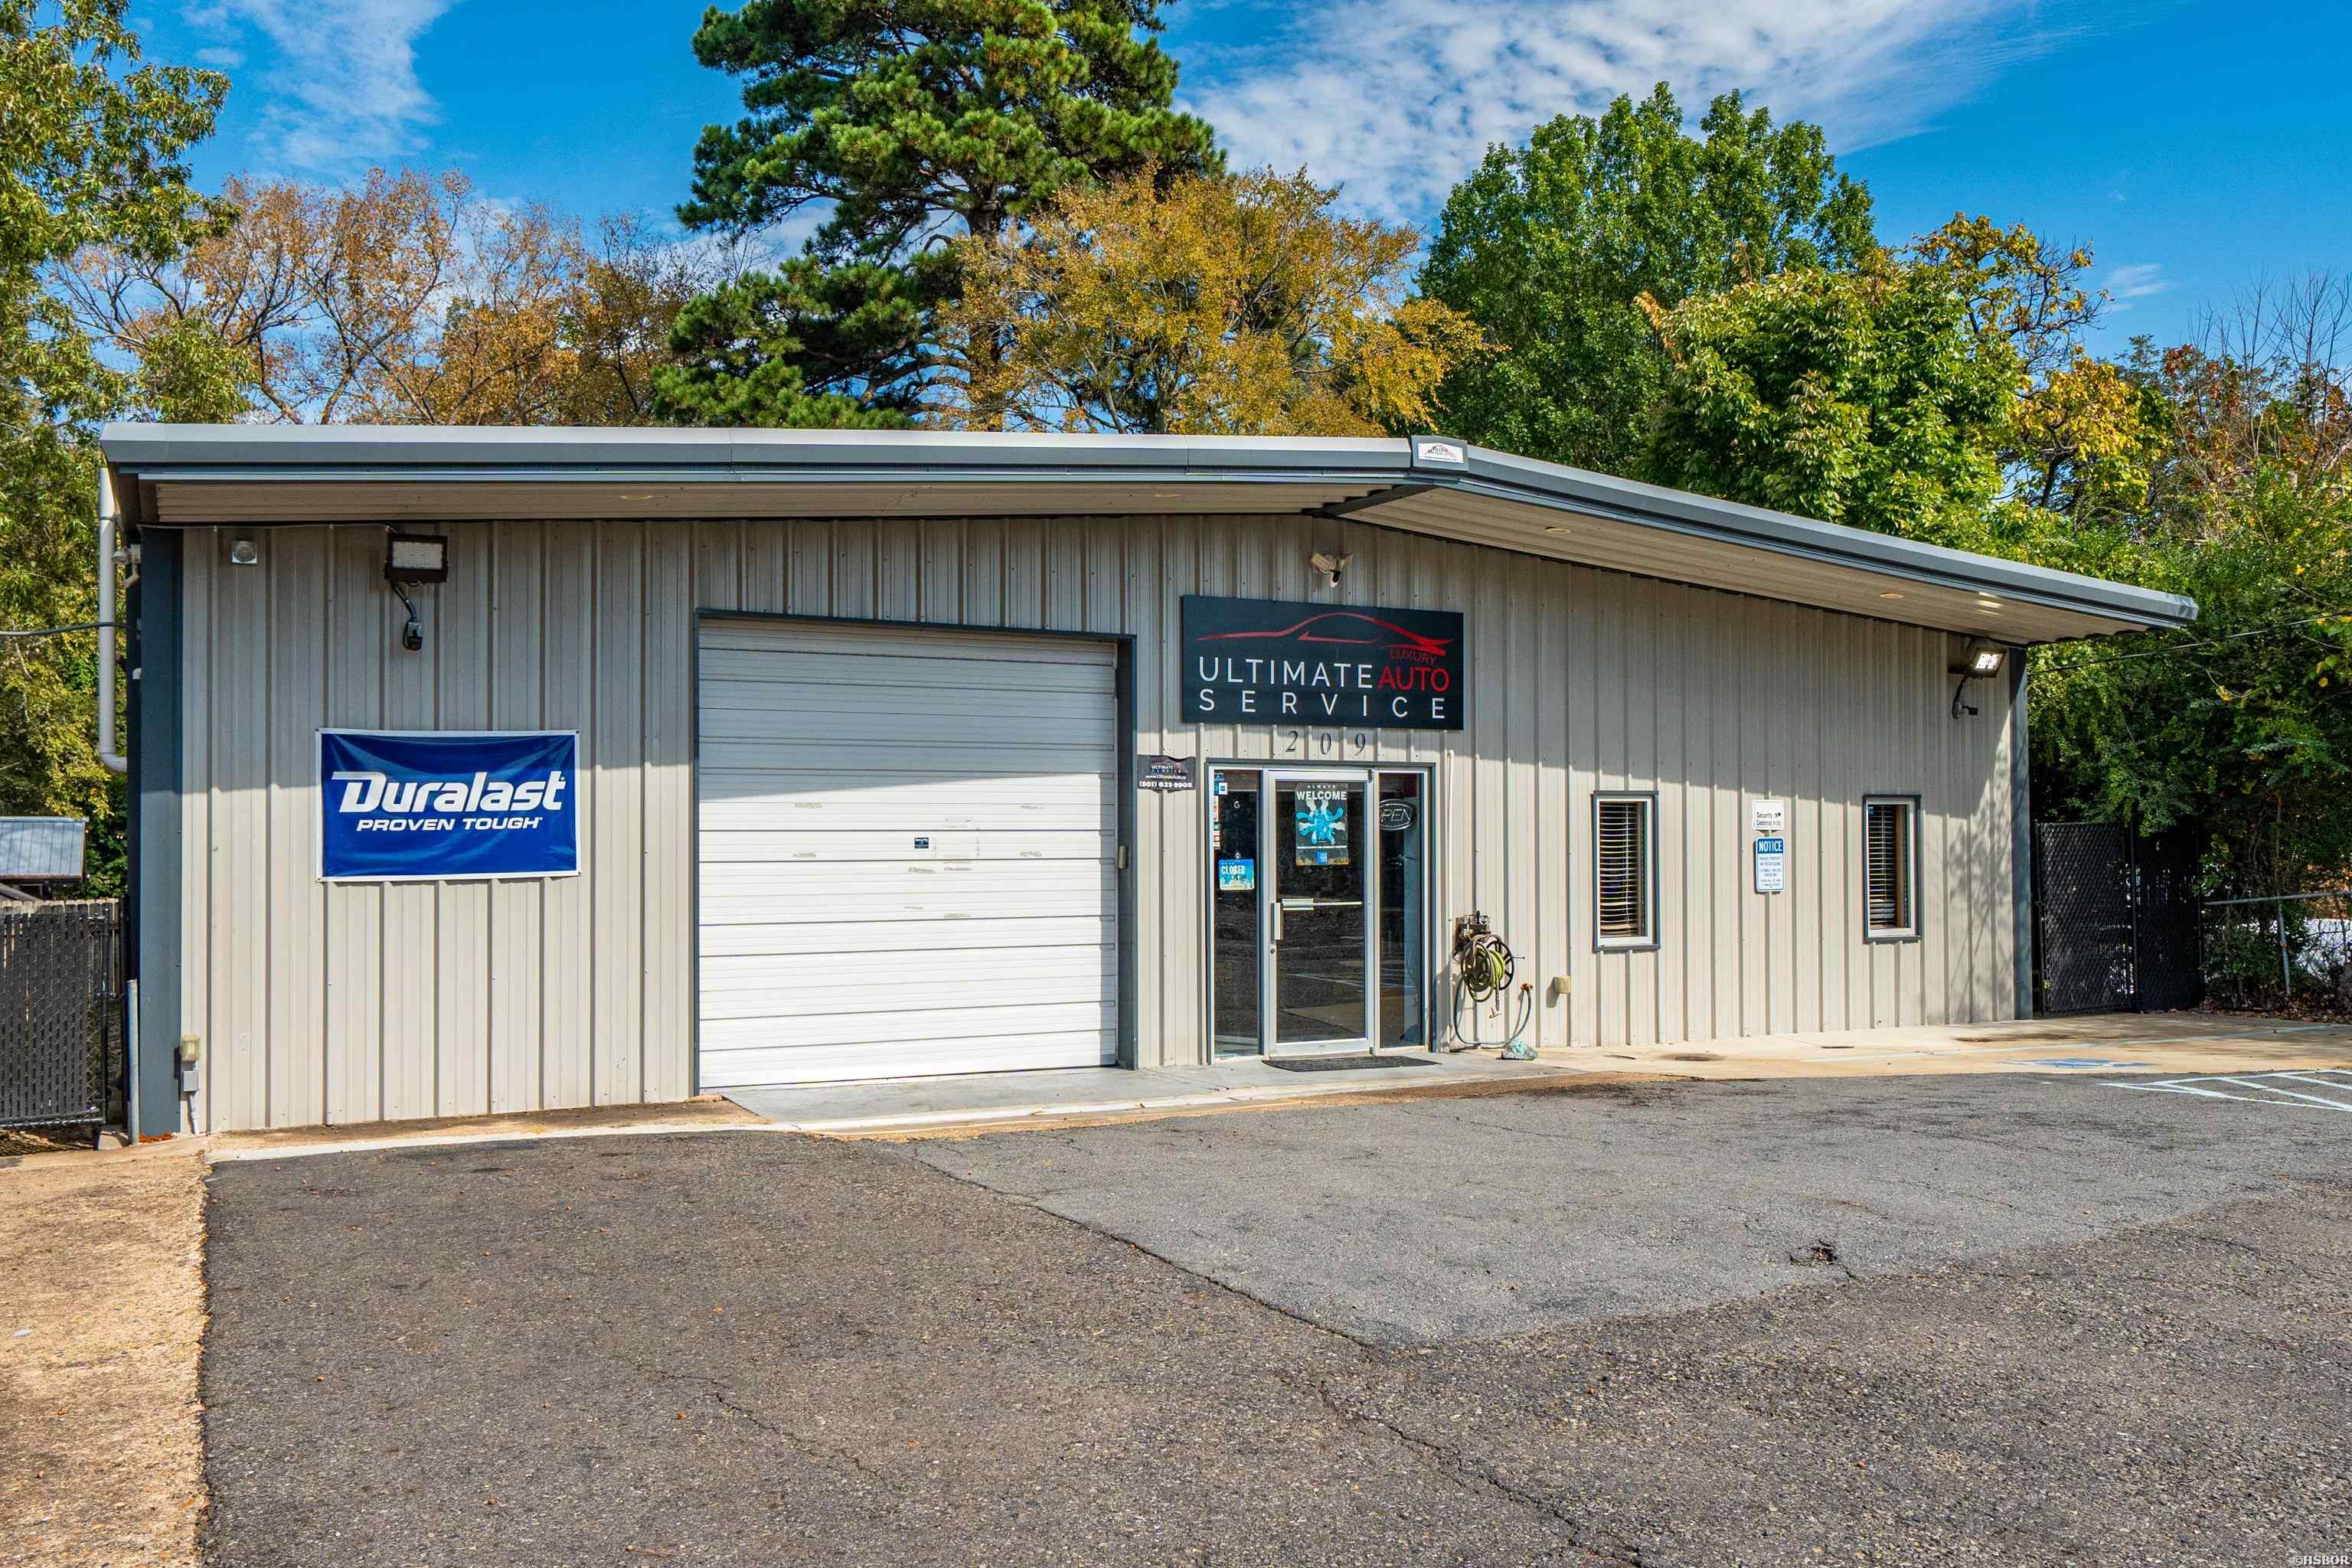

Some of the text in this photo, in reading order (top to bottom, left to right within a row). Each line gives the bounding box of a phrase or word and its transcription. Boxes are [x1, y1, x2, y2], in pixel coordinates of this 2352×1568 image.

[1390, 649, 1438, 665] LUXURY
[1199, 656, 1451, 692] ULTIMATE AUTO
[1199, 688, 1446, 720] SERVICE
[1285, 730, 1367, 756] 209
[332, 771, 566, 812] Duralast
[1296, 791, 1348, 800] WELCOME
[1380, 808, 1410, 822] PEN
[356, 817, 541, 831] PROVEN TOUGH
[1759, 840, 1782, 852] NOTICE
[1221, 865, 1245, 874] CLOSED
